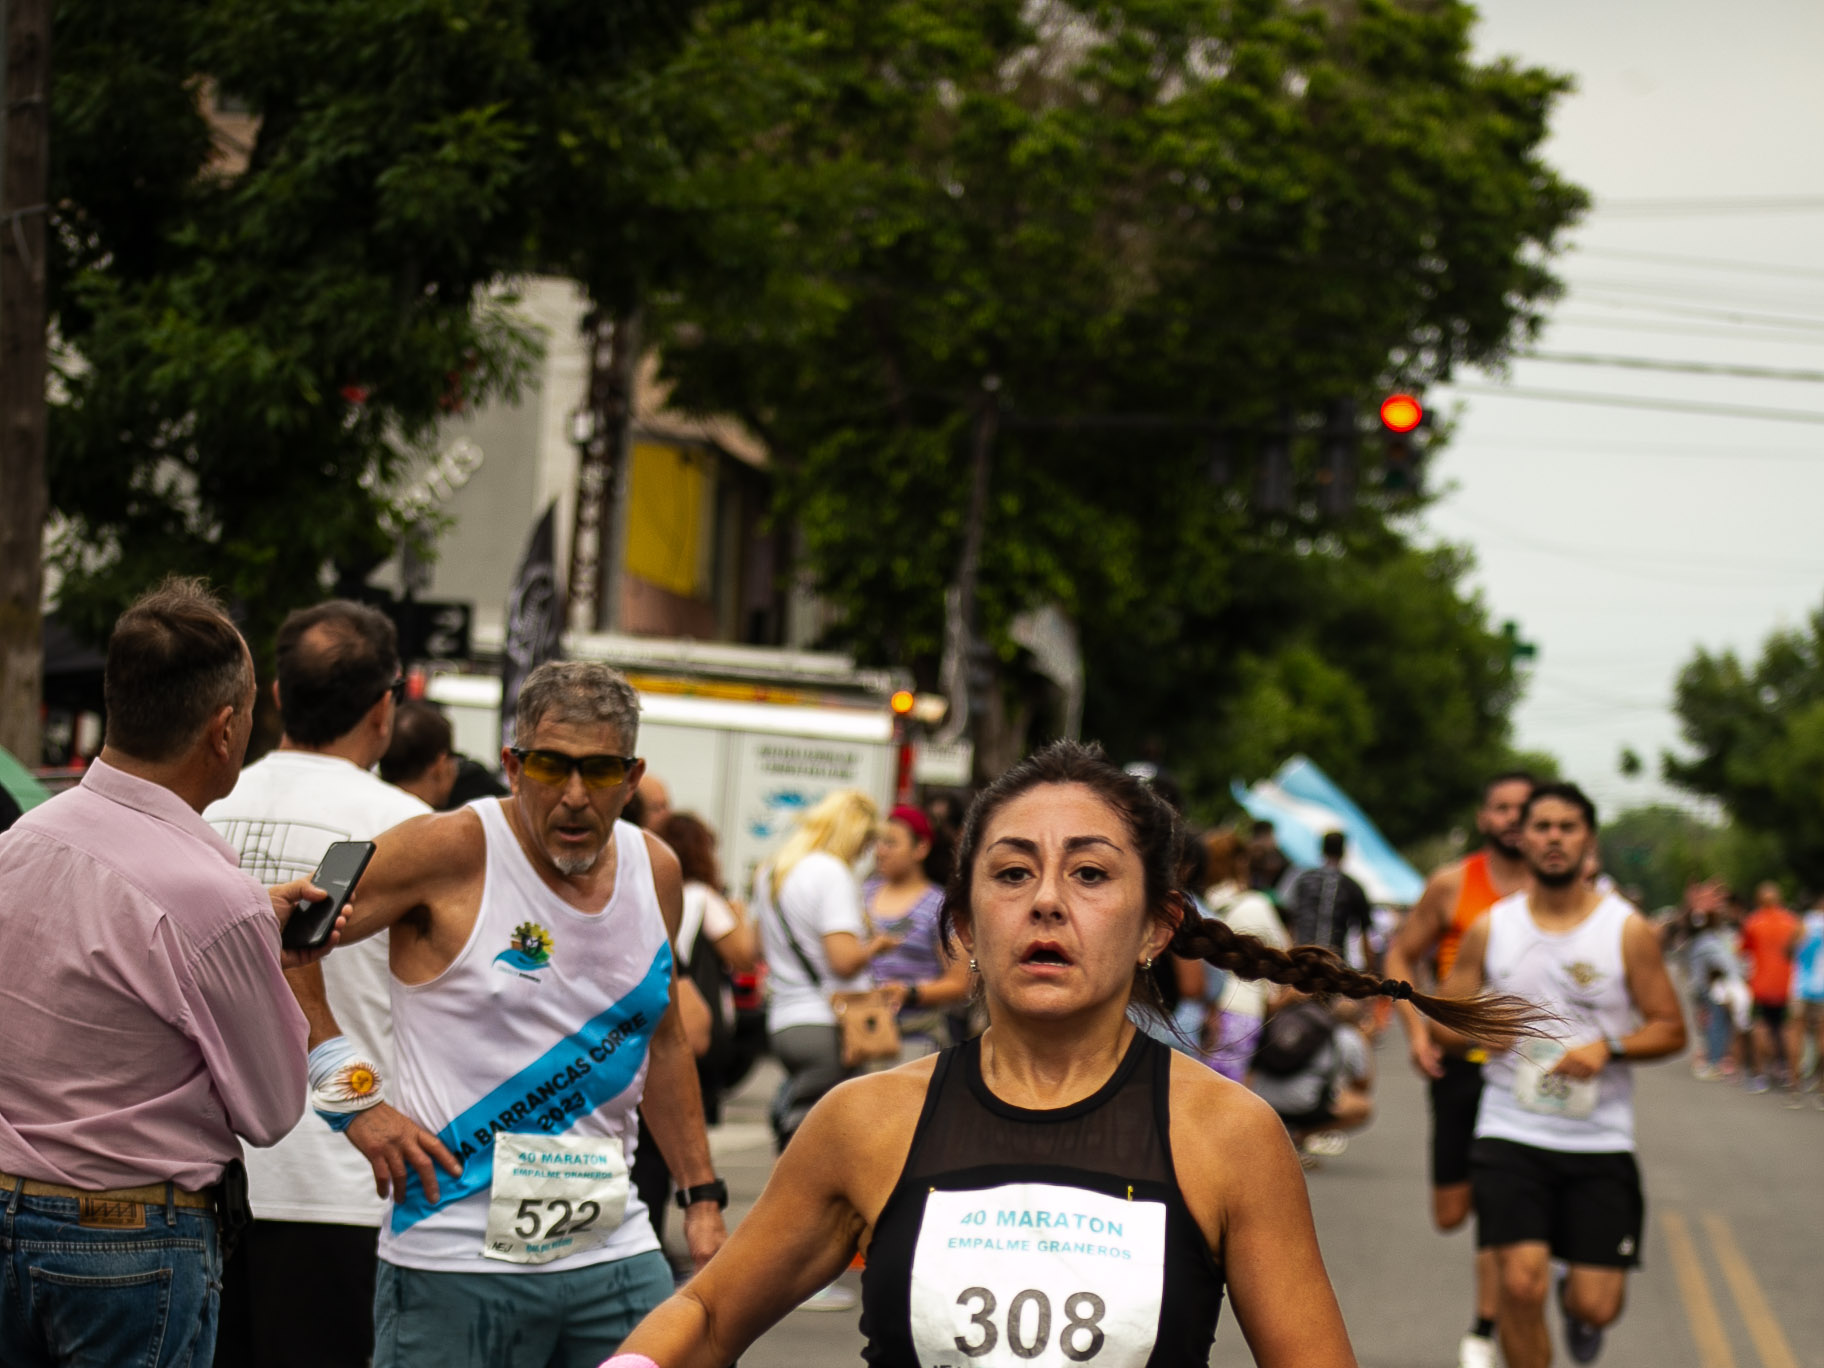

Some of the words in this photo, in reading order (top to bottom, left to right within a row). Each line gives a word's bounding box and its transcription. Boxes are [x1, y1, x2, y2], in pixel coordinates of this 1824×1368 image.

[475, 1062, 593, 1146] BARRANCAS
[589, 1012, 648, 1064] CORRE
[536, 1092, 586, 1134] 2023
[517, 1152, 536, 1164] 40
[541, 1153, 608, 1165] MARATON
[515, 1199, 601, 1240] 522
[960, 1210, 988, 1227] 40
[996, 1210, 1124, 1237] MARATON
[947, 1236, 1031, 1252] EMPALME
[1036, 1240, 1132, 1261] GRANEROS
[953, 1286, 1107, 1363] 308
